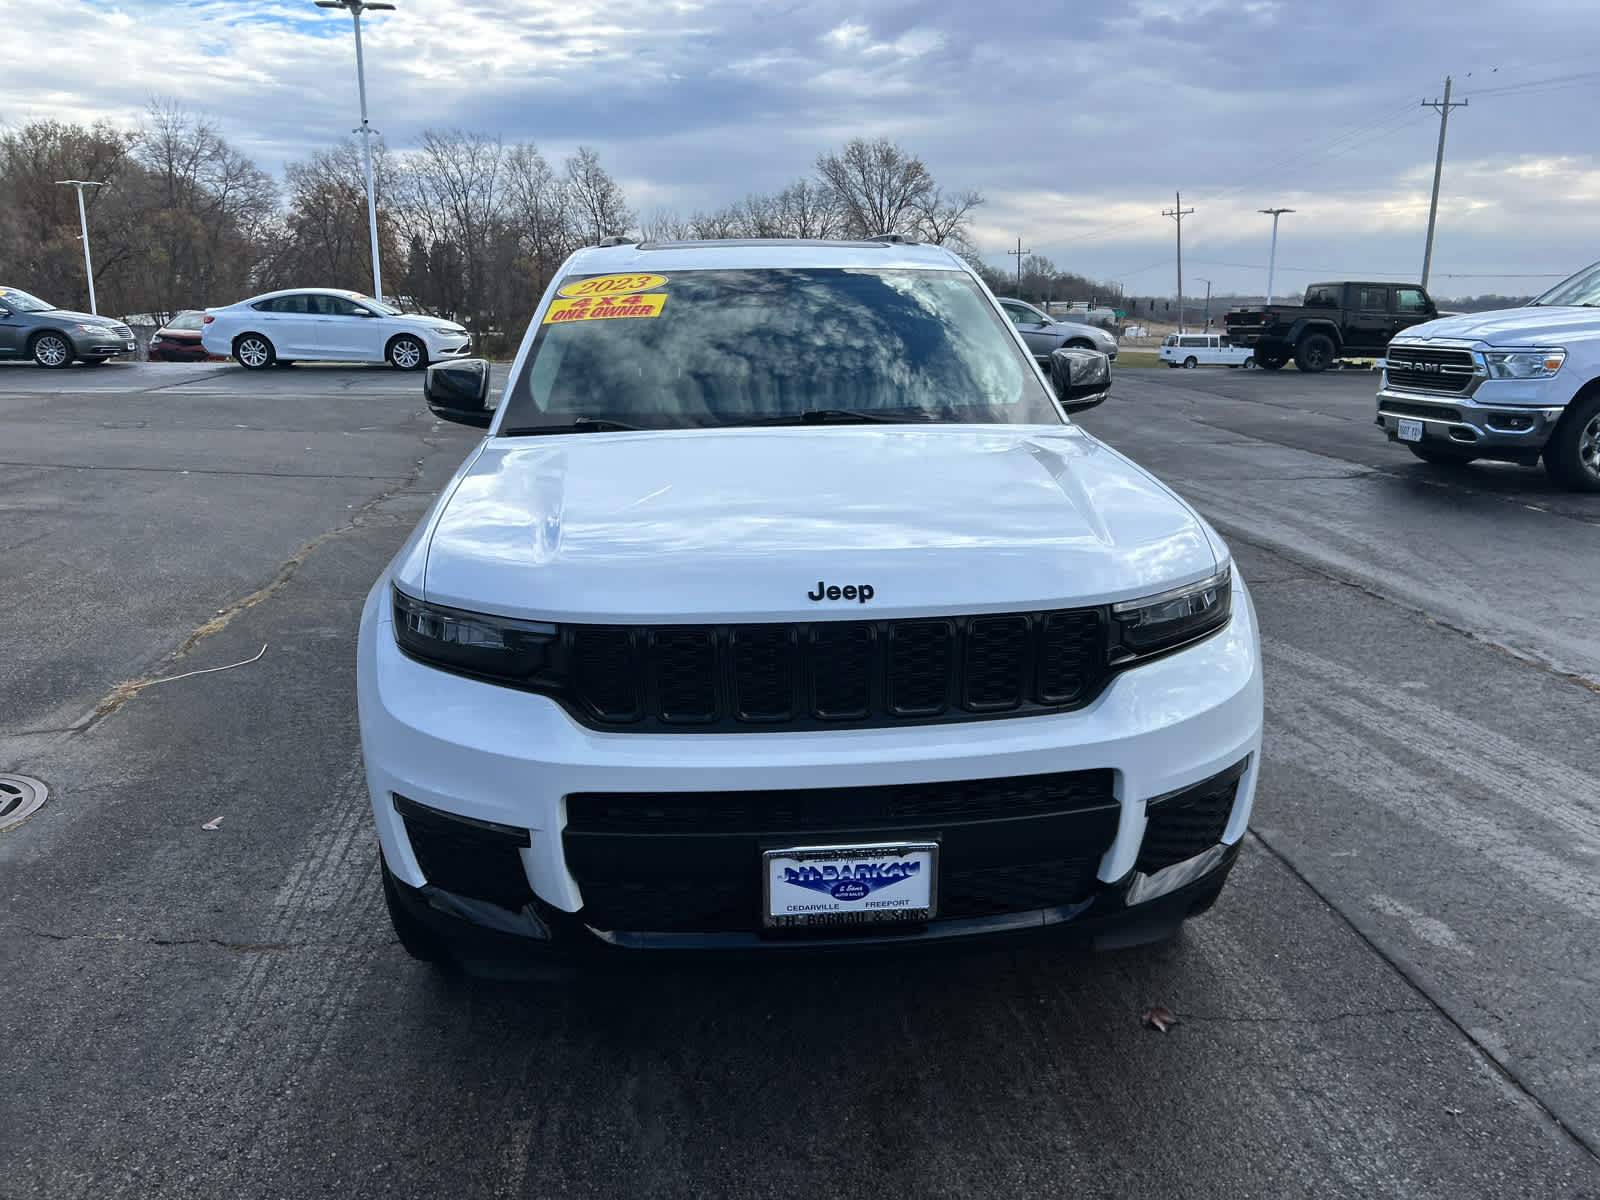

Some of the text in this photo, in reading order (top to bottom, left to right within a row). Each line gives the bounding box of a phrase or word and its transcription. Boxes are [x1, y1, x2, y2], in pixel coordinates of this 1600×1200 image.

[575, 275, 652, 295] 2023
[551, 305, 655, 321] ONE OWNER
[807, 581, 875, 604] Jeep
[786, 903, 840, 912] CEDARVILLE
[865, 899, 911, 909] FREEPORT
